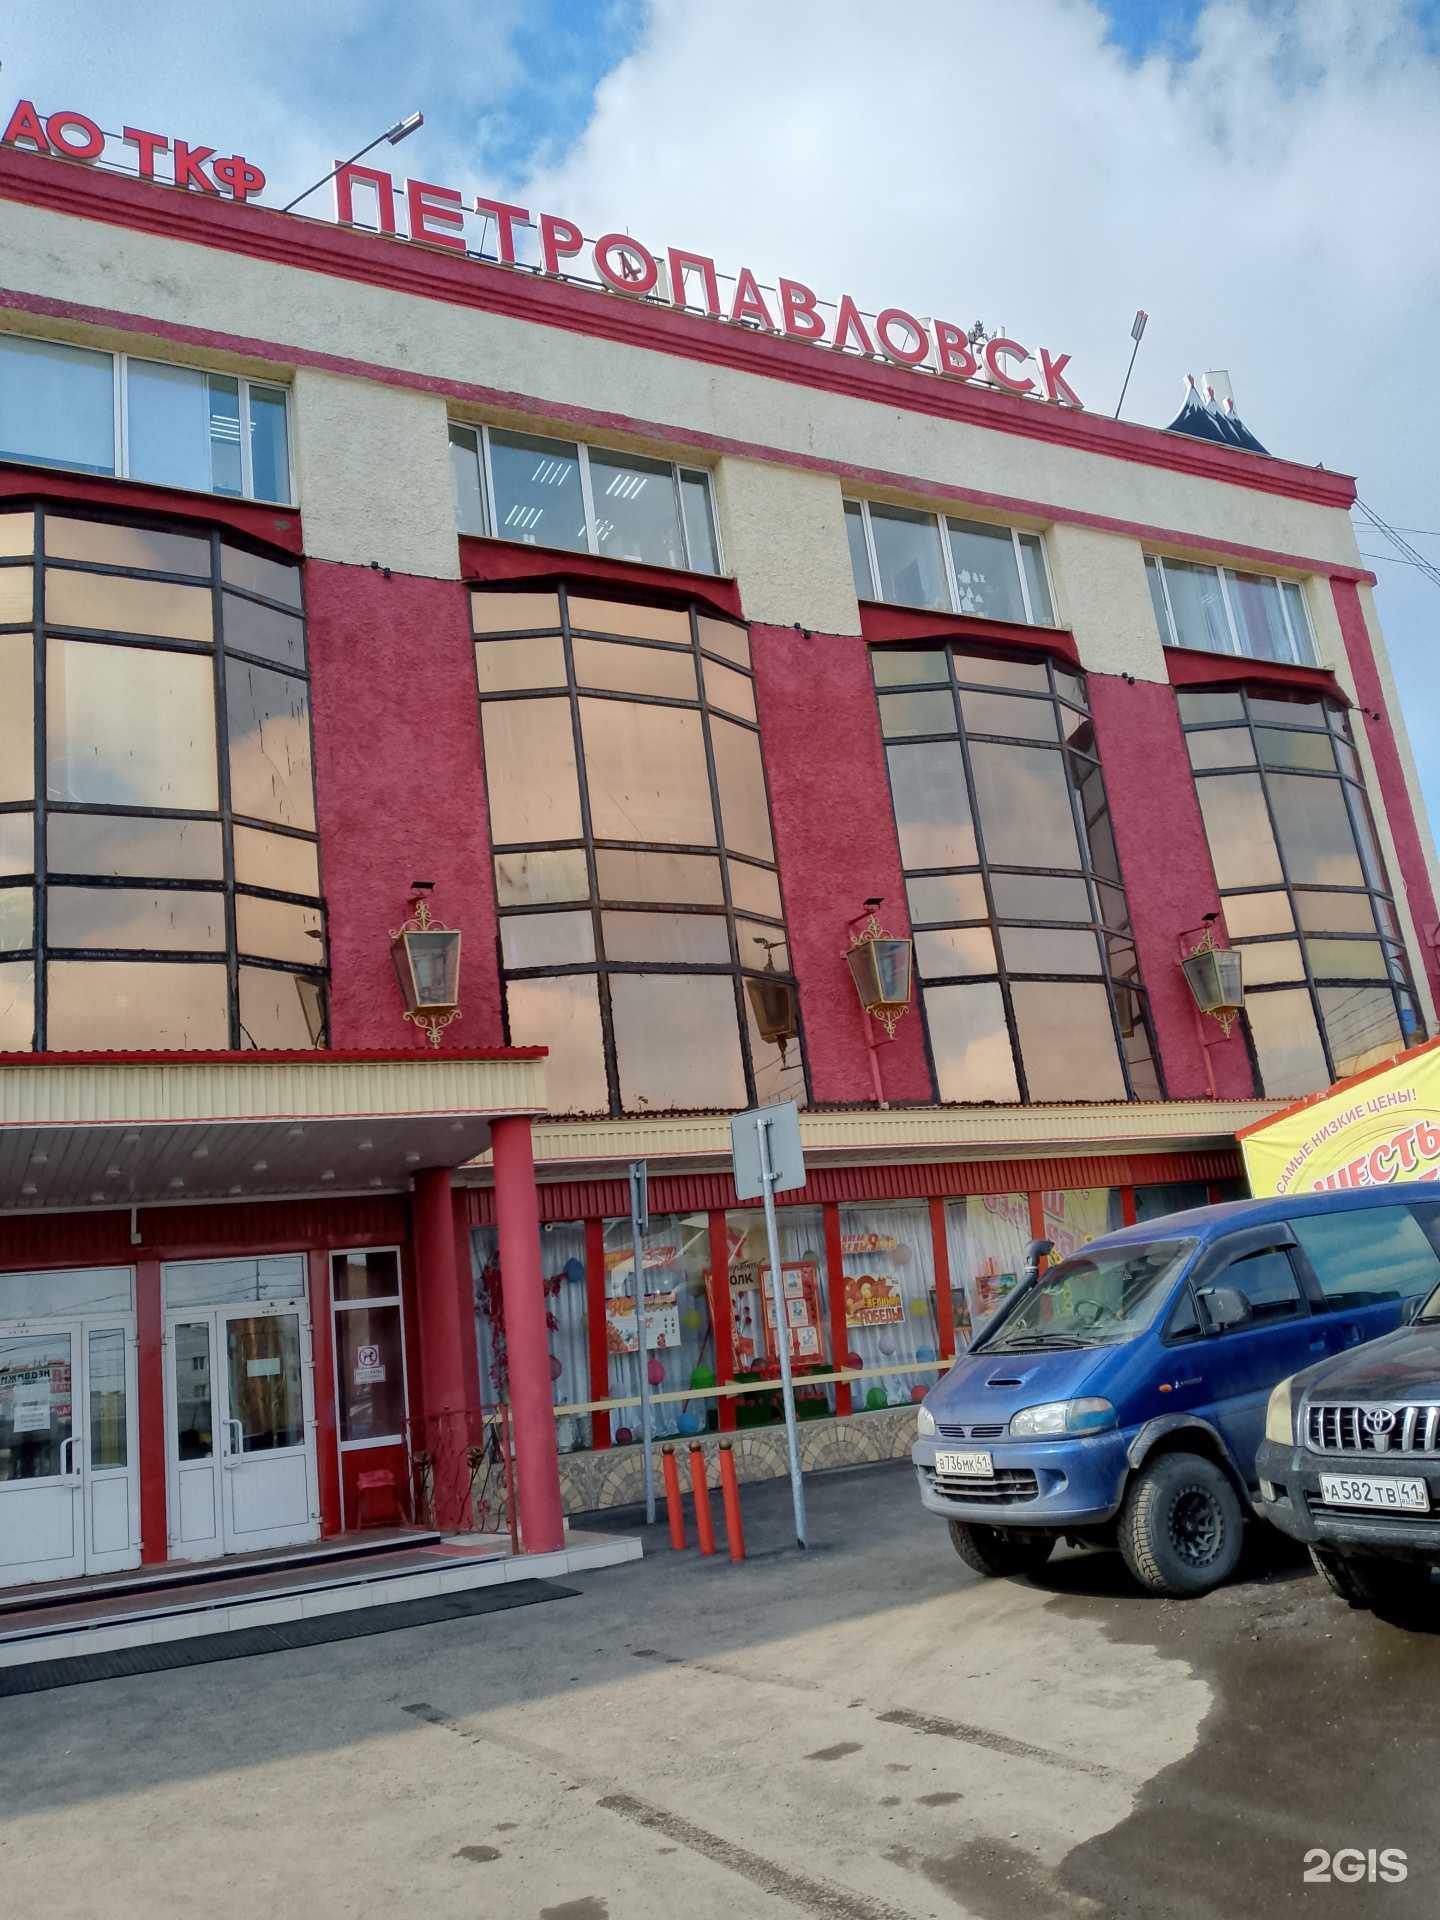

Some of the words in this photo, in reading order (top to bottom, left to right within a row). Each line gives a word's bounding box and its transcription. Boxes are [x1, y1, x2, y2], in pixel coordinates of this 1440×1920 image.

[2, 99, 106, 164] АО
[122, 125, 266, 202] ТКФ
[333, 159, 1085, 411] ПЕТРОПАВЛОВСК
[1276, 1142, 1314, 1194] САМЫЕ
[1312, 1104, 1366, 1148] НИЗКИЕ
[1367, 1088, 1417, 1113] ЦЕНЫ!
[730, 1273, 753, 1285] ОЛК
